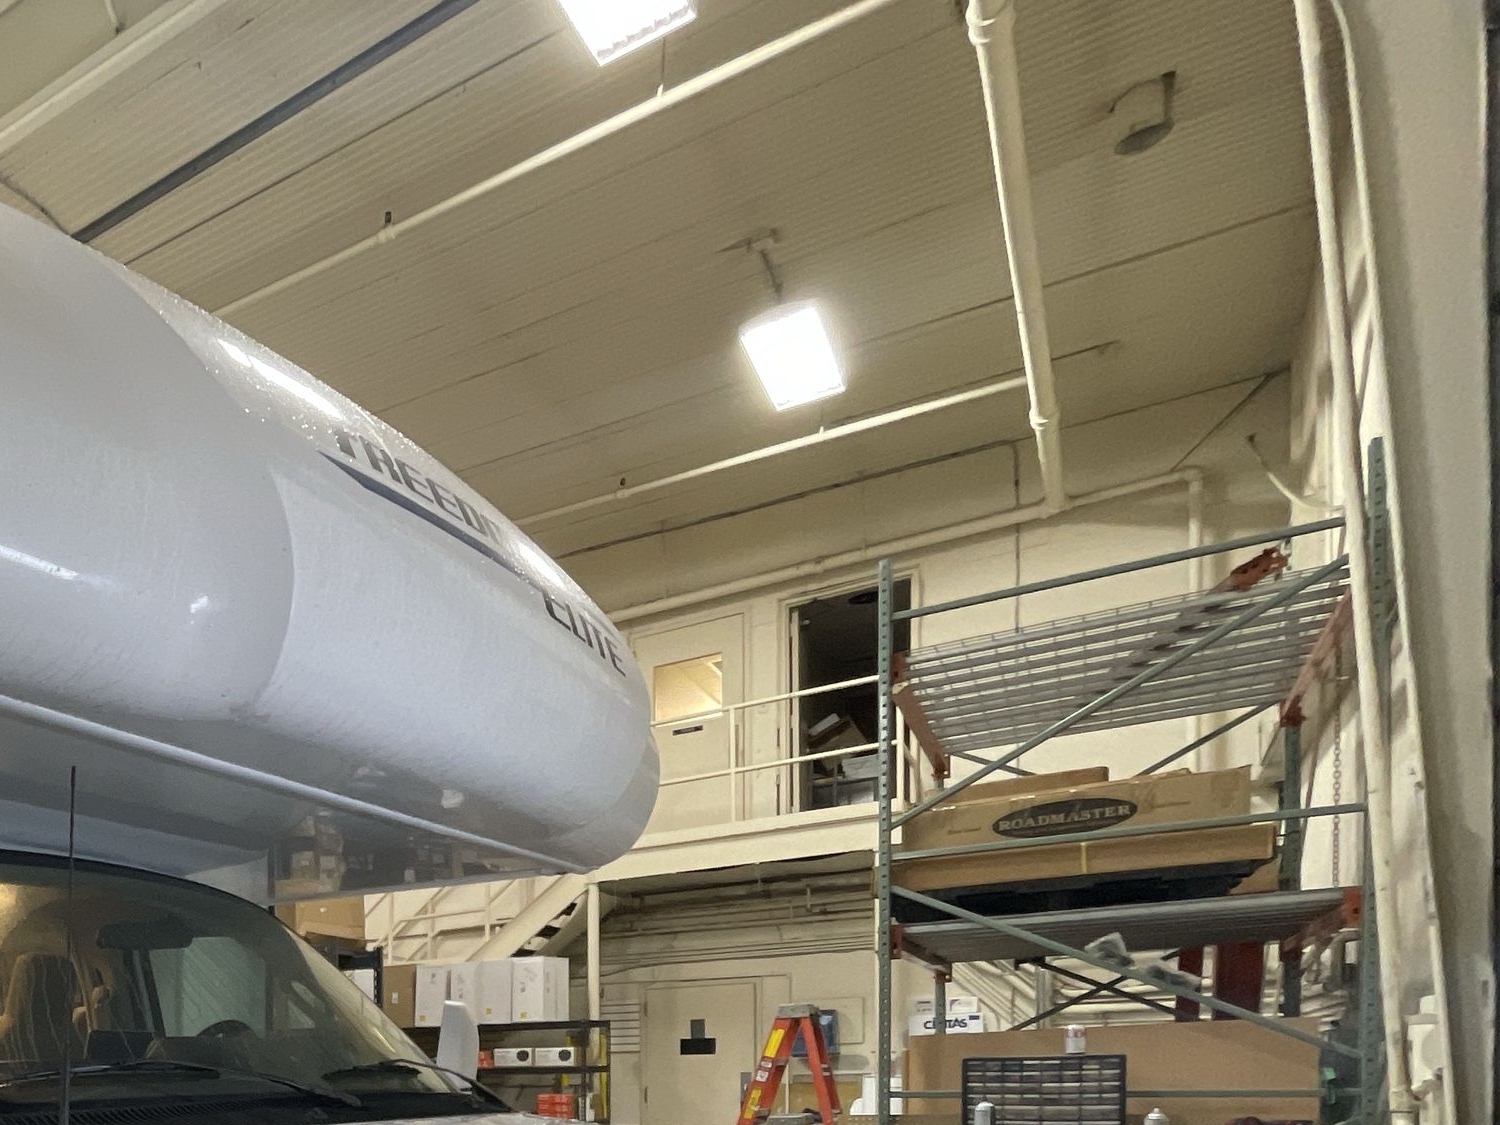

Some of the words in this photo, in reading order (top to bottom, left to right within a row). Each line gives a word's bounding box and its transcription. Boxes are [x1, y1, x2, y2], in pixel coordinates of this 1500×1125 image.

[542, 588, 627, 678] ELITE
[998, 804, 1132, 832] ROADMASTER
[923, 1017, 968, 1029] CITAS
